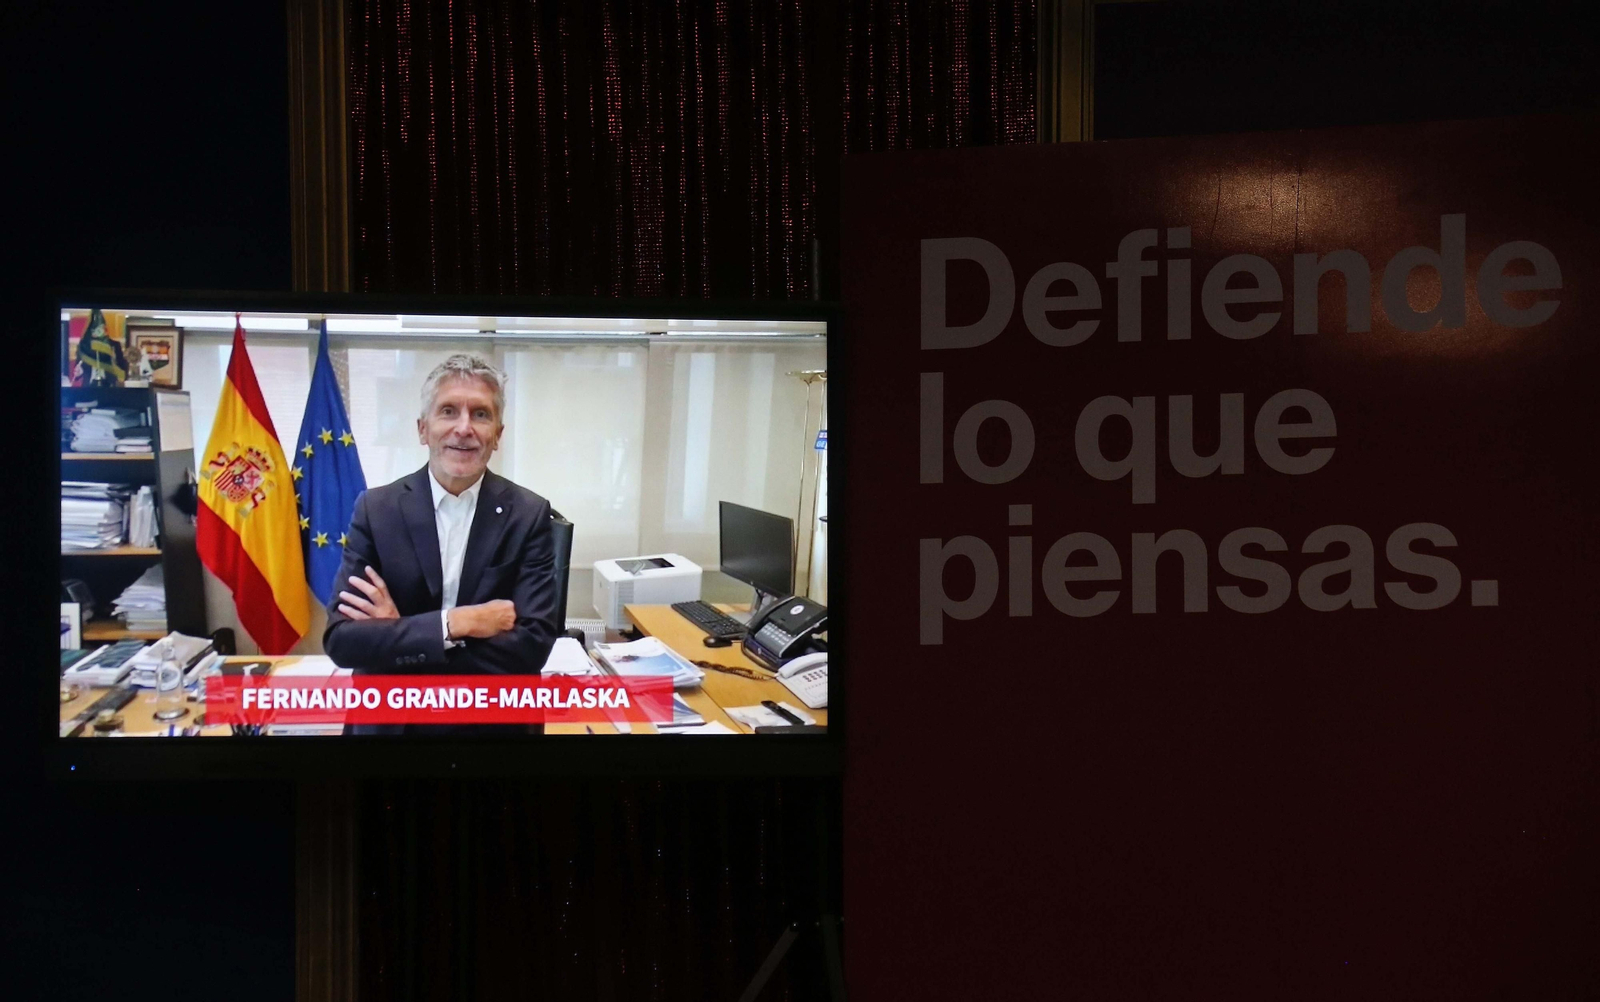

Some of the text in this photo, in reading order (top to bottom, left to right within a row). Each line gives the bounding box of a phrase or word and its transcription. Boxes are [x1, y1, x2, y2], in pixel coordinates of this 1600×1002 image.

[920, 213, 1563, 350] Defiende
[919, 371, 1338, 504] lo que
[919, 504, 1499, 645] piensas.
[242, 687, 631, 710] FERNANDO GRANDE-MARLASKA
